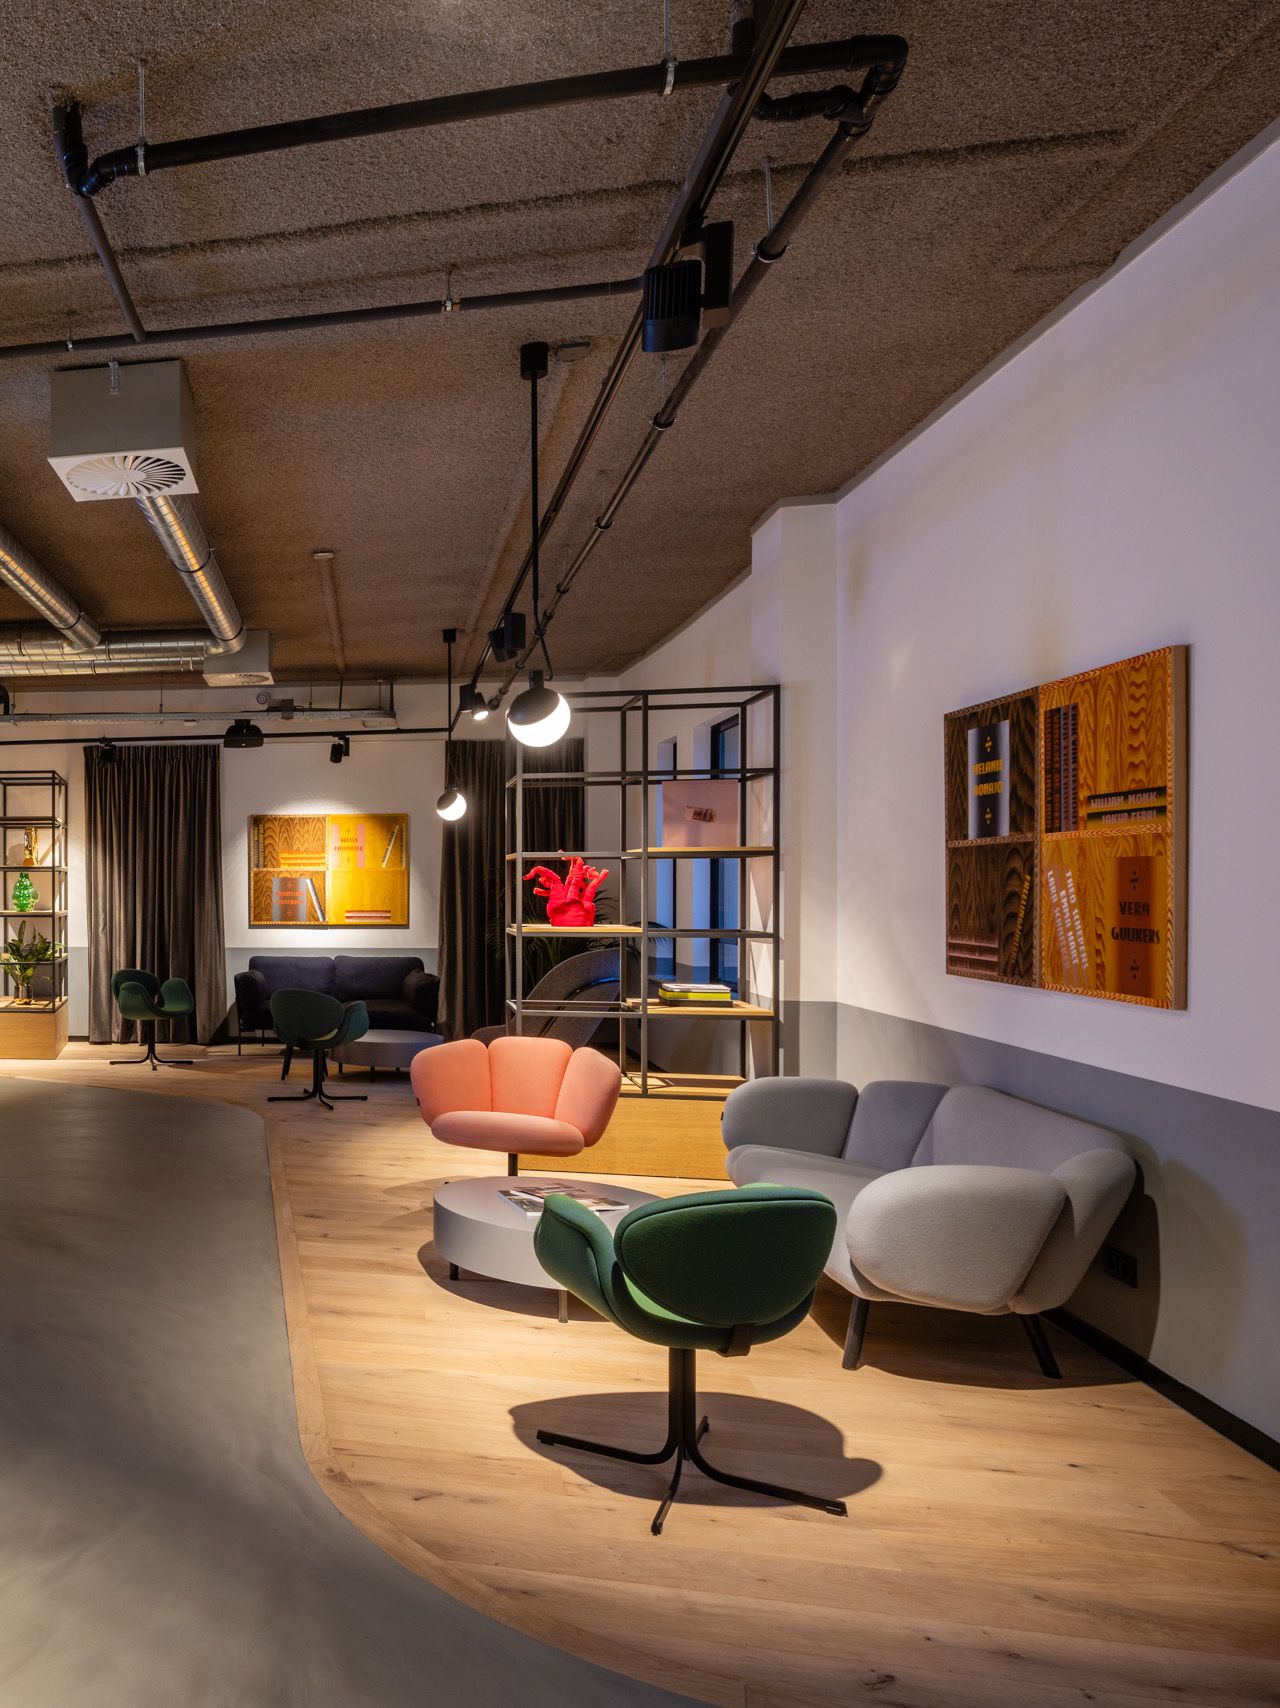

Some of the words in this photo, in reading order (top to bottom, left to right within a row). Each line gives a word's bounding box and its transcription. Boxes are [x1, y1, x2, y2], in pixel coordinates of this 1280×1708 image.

[1090, 795, 1124, 809] WILLIAM
[1128, 791, 1157, 805] MONK
[1060, 889, 1071, 927] EMMA
[1066, 869, 1076, 904] THEO
[1073, 909, 1088, 969] SCHEPENS
[1119, 900, 1150, 916] VERA
